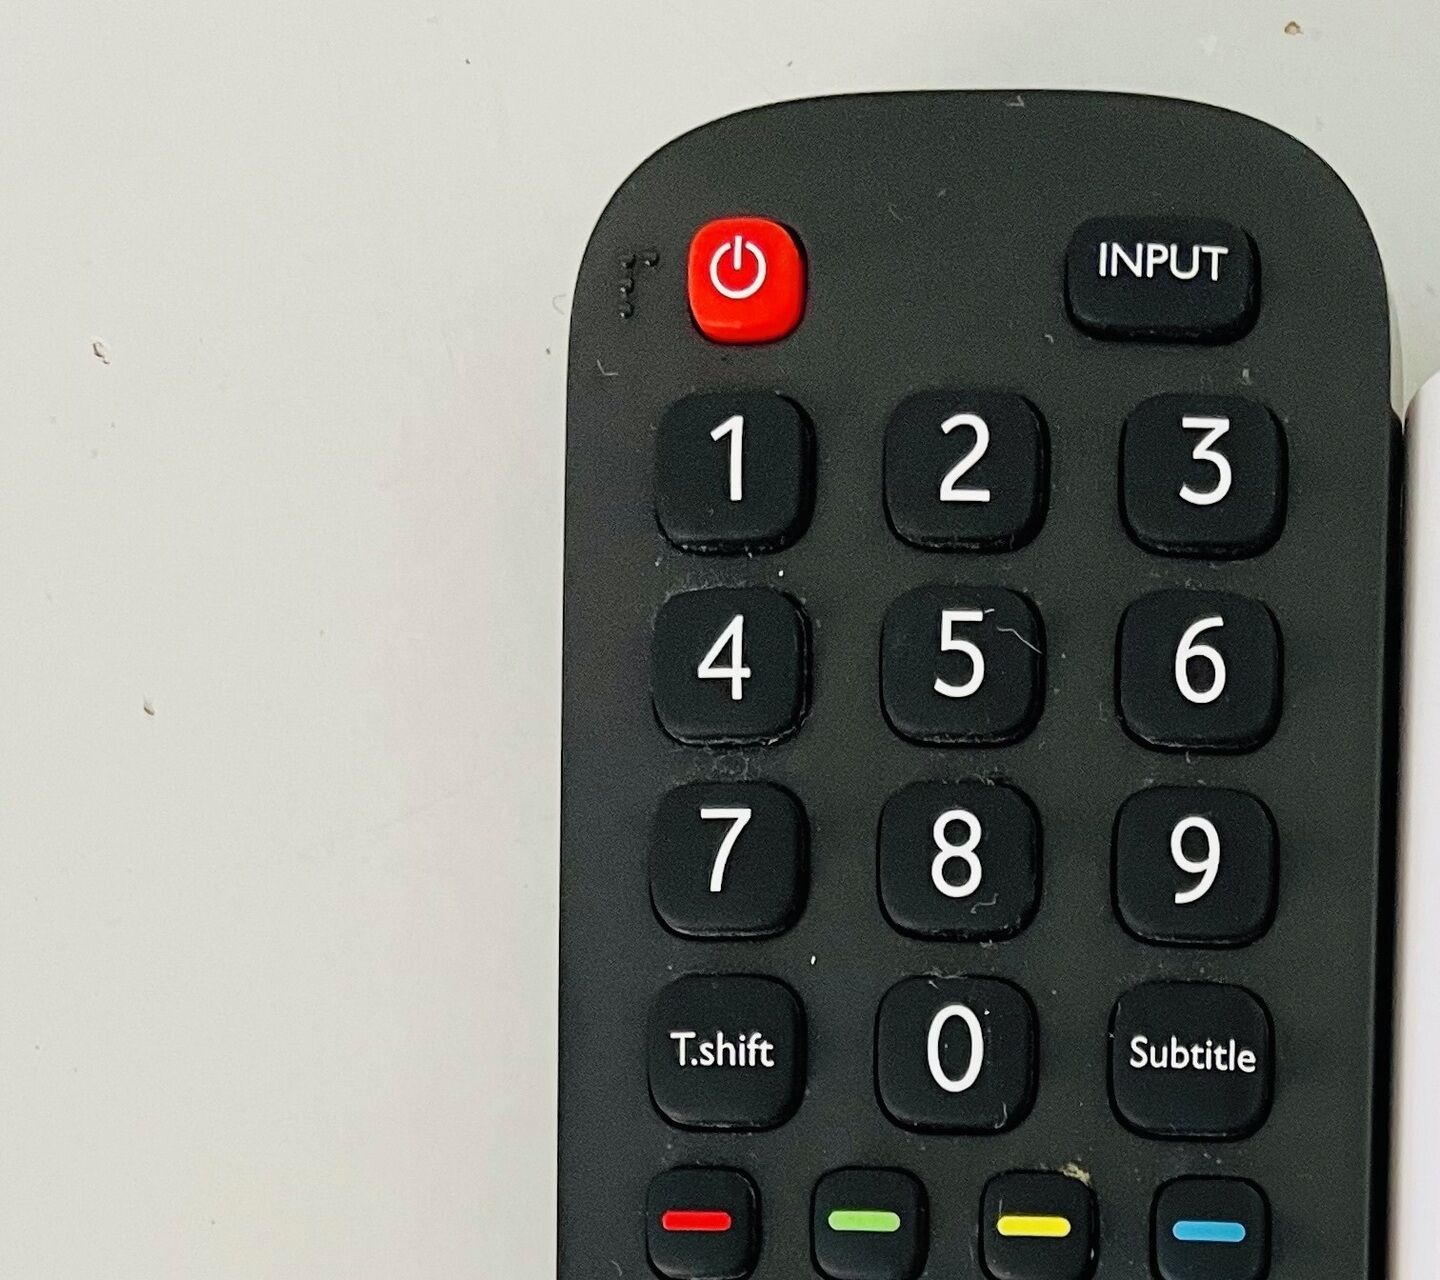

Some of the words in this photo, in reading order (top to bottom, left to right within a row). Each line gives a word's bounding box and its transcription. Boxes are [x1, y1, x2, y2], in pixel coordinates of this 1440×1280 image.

[1099, 243, 1228, 280] INPUT
[711, 416, 743, 500] 1
[940, 414, 990, 501] 2
[1180, 417, 1231, 505] 3
[698, 615, 751, 700] 4
[933, 610, 984, 698] 5
[1176, 617, 1225, 703] 6
[701, 808, 751, 891] 7
[932, 810, 981, 897] 8
[1171, 817, 1220, 903] 9
[670, 1032, 774, 1067] T.shift
[927, 1005, 984, 1092] 0
[1130, 1036, 1256, 1072] Subtitle
